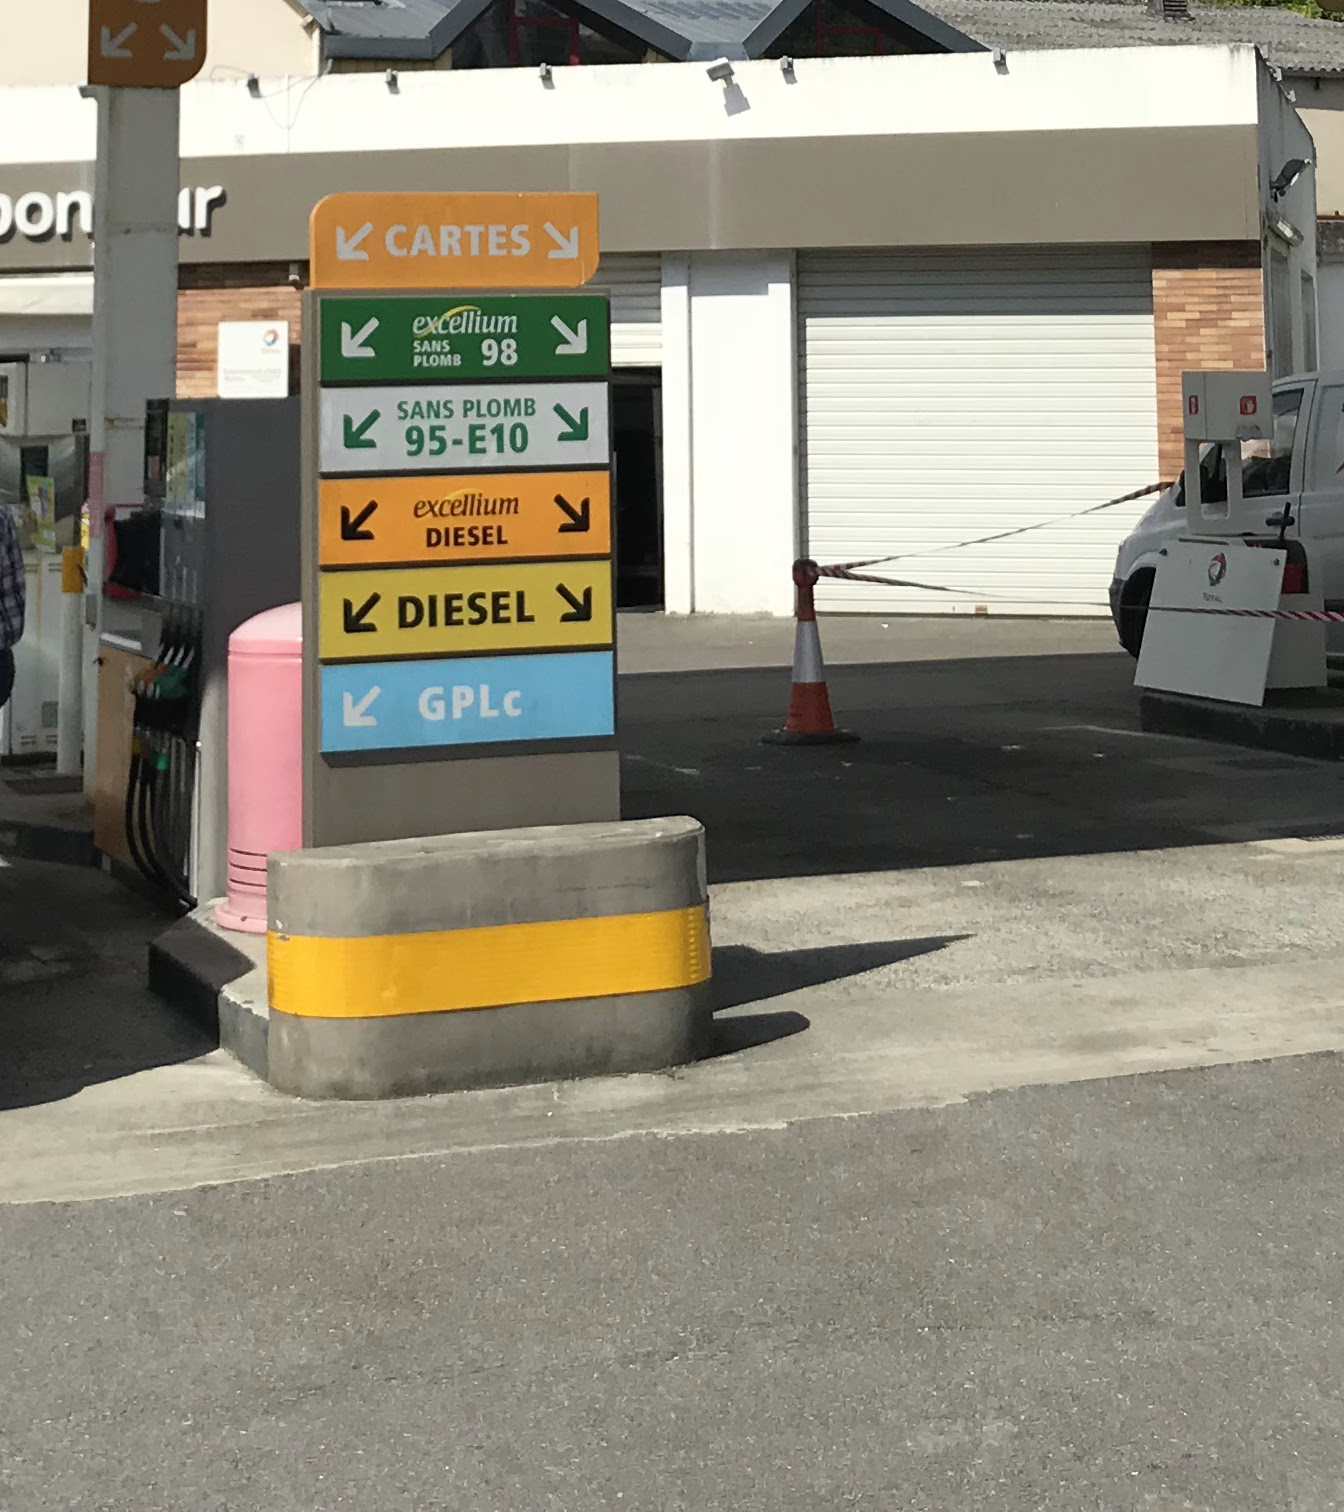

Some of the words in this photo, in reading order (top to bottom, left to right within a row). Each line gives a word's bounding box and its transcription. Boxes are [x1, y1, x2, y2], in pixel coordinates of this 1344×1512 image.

[385, 223, 531, 257] CARTES
[412, 308, 518, 336] excellium
[413, 340, 450, 354] SANS
[481, 338, 518, 366] 98
[413, 353, 462, 367] PLOMB
[397, 400, 455, 421] SANS
[462, 398, 536, 419] PLOMB
[405, 423, 529, 457] 95-E10
[413, 492, 519, 519] excellium
[426, 525, 508, 548] DIESEL
[397, 590, 534, 629] DIESEL
[418, 685, 522, 722] GPLc
